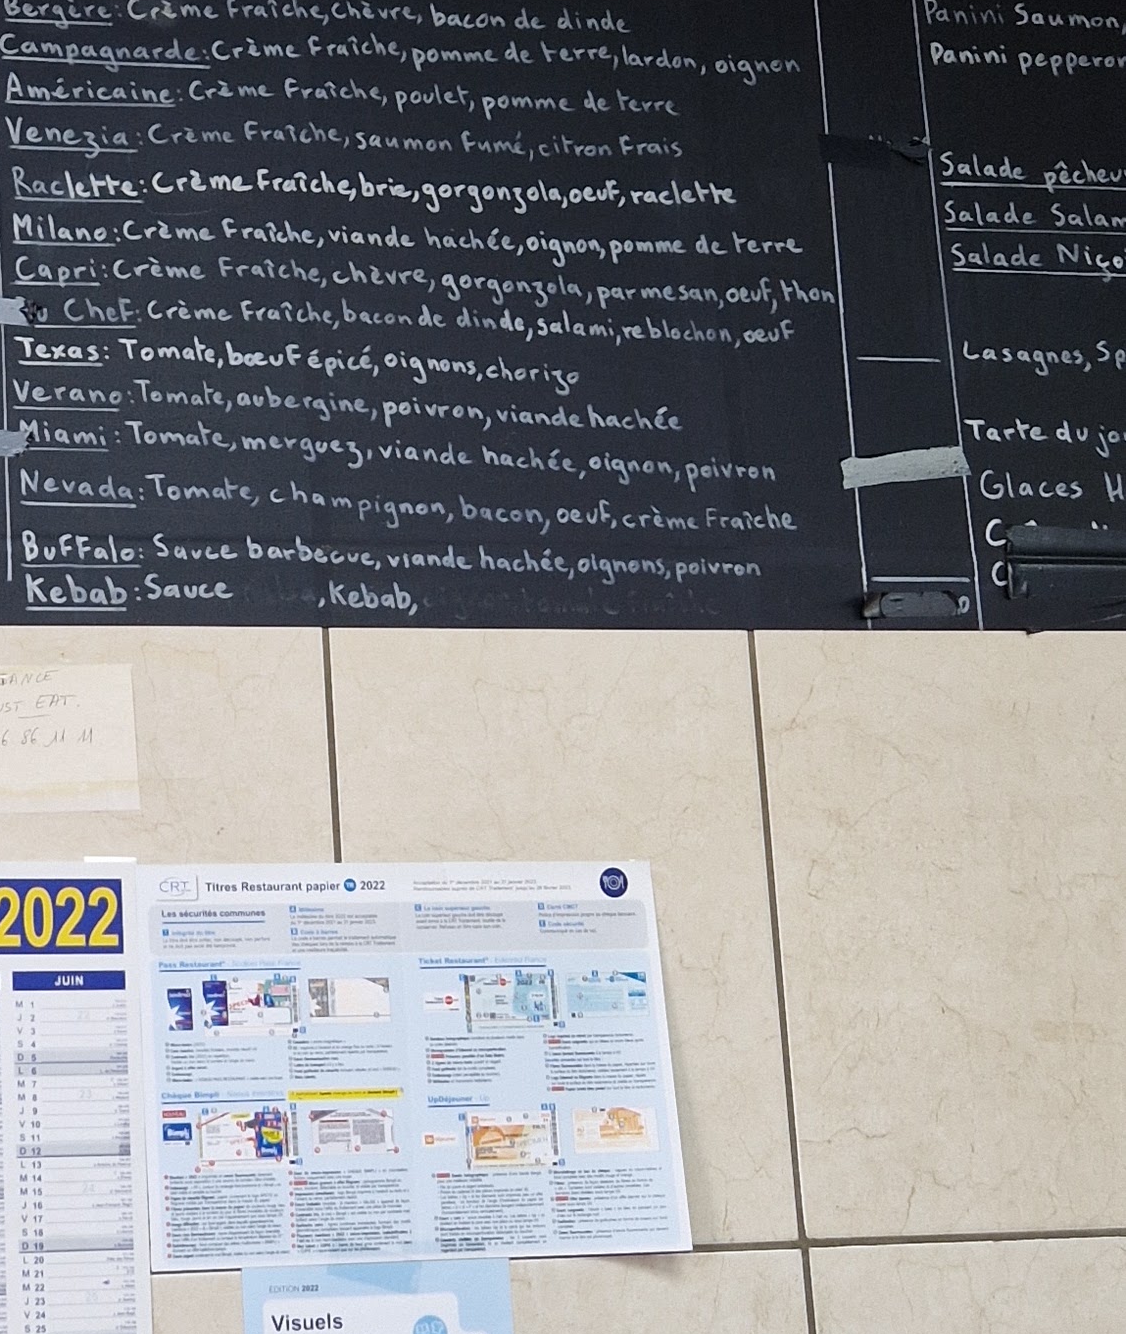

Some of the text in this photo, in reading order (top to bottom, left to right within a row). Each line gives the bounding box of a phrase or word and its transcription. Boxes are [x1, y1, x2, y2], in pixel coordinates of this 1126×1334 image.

[430, 0, 506, 29] bacon
[514, 11, 542, 30] de
[557, 11, 631, 34] dinde
[930, 42, 1007, 65] Panini
[940, 151, 1126, 193] Salade pêcheu
[944, 200, 1037, 226] Salade
[950, 242, 1126, 282] Salade Niço
[485, 360, 580, 395] chorizo
[963, 418, 1048, 442] Tarte
[1056, 420, 1088, 443] du
[980, 470, 1082, 499] Glaces
[144, 576, 233, 602] Sauce
[206, 882, 237, 892] Titres
[241, 882, 302, 891] Restaurant
[306, 881, 340, 893] papier
[360, 881, 386, 890] 2022
[162, 910, 179, 918] Les
[181, 910, 218, 918] sécurités
[54, 975, 83, 986] JUIN
[302, 1284, 320, 1292] 2022
[271, 1313, 343, 1331] Visuels
